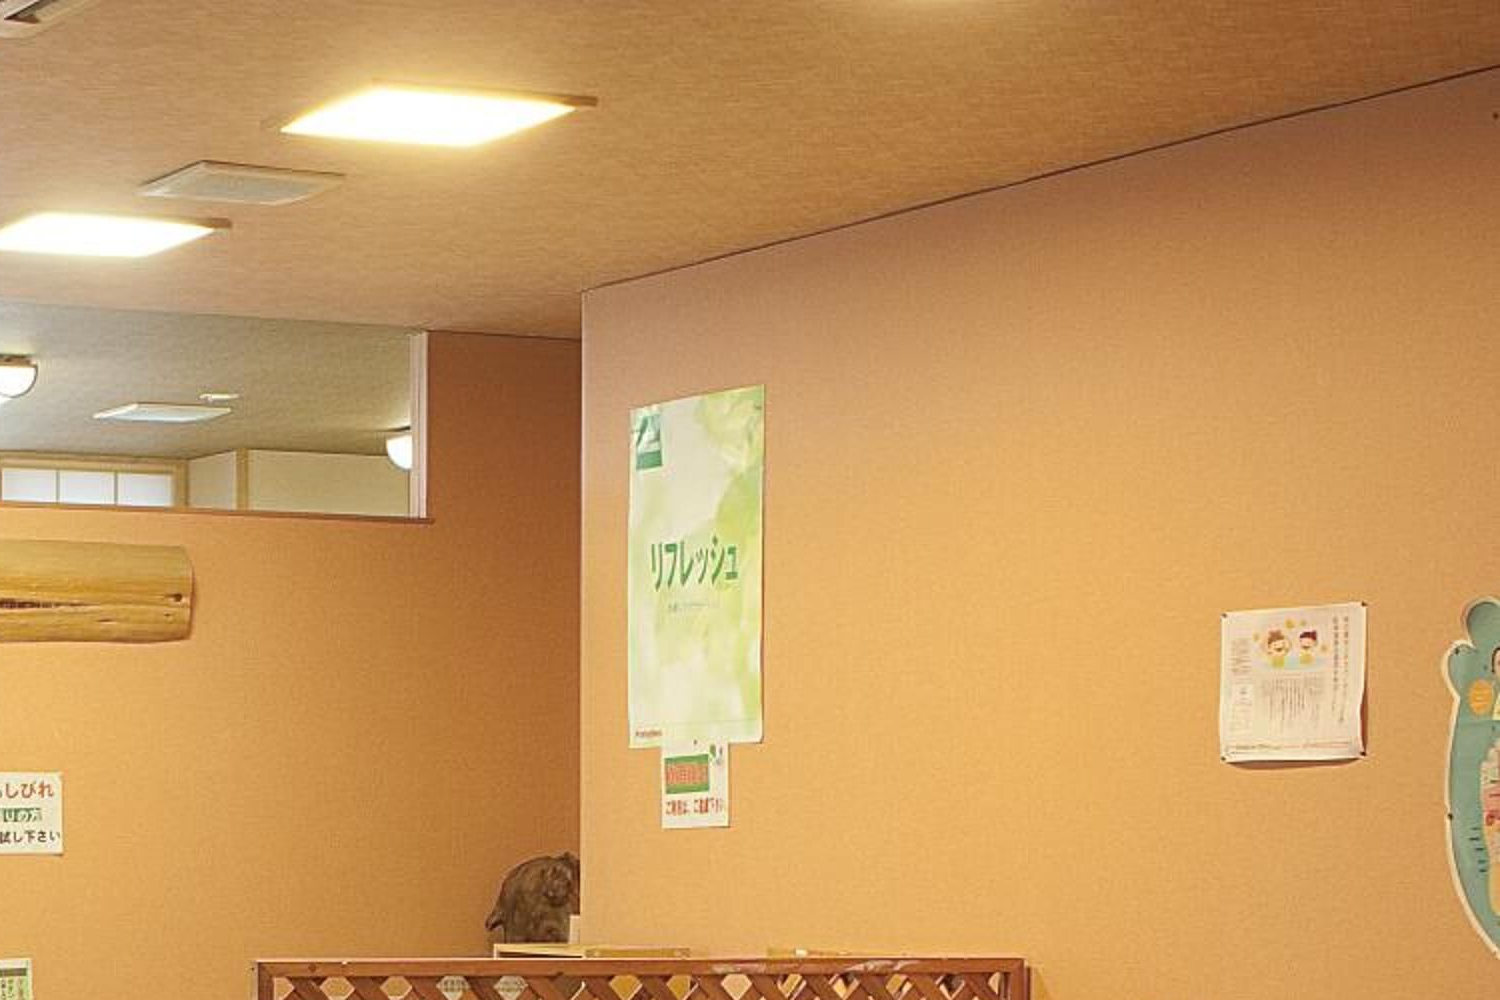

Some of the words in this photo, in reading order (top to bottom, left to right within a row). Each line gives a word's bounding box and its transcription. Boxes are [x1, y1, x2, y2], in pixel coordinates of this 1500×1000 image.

[651, 534, 739, 592] リフレッシュ
